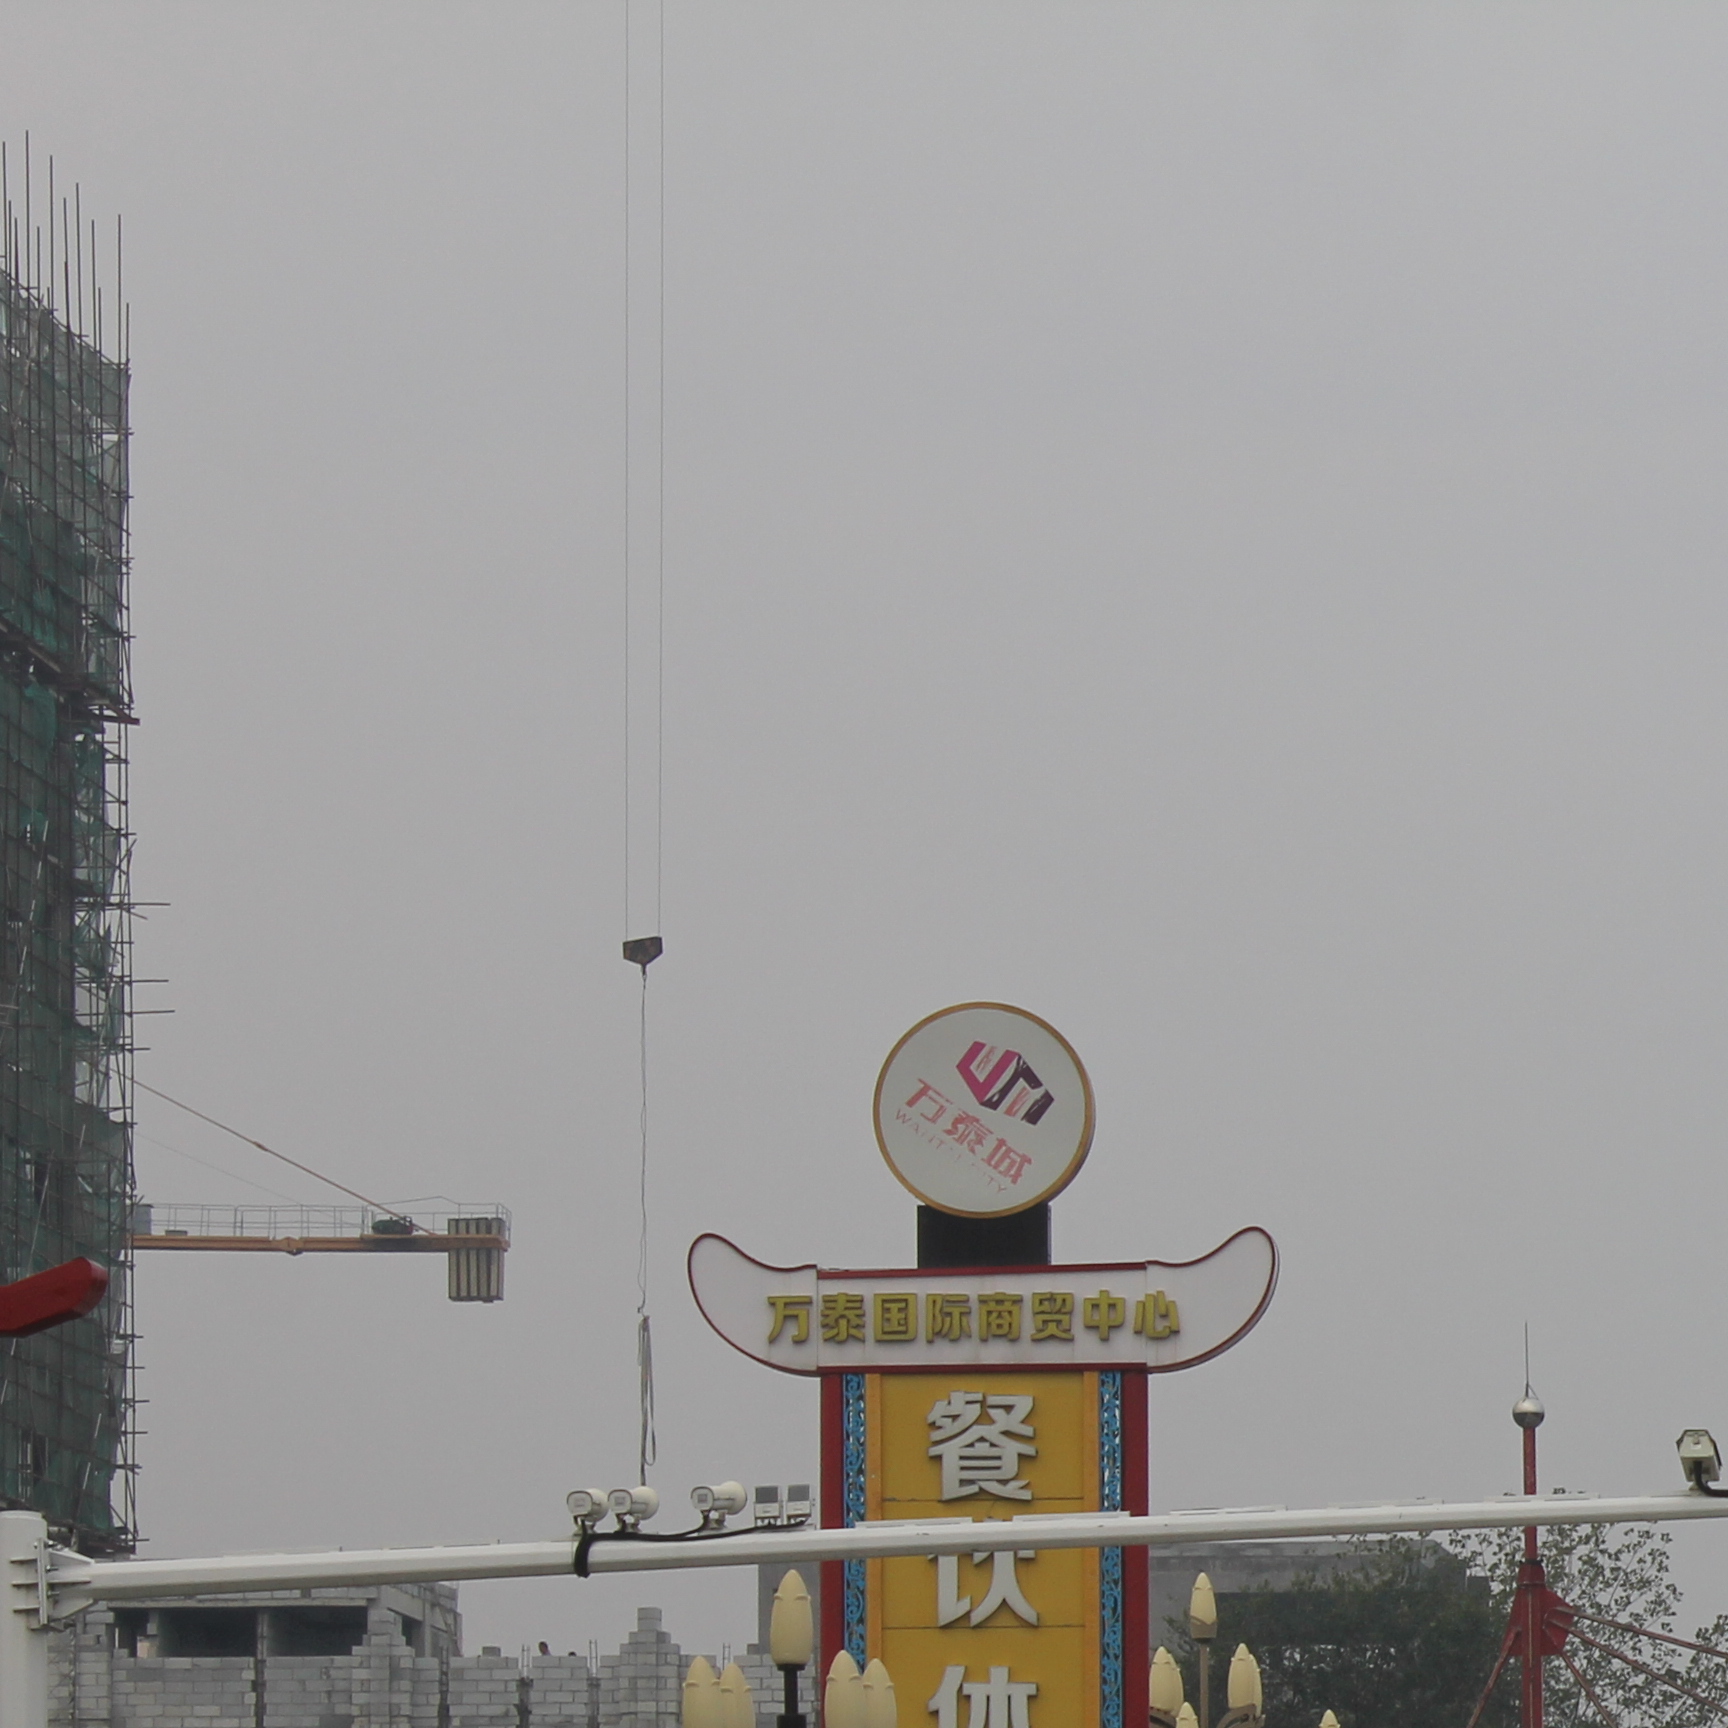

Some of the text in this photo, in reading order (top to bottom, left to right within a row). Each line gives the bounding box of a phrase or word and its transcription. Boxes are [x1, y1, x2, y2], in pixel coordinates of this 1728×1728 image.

[906, 1077, 1033, 1186] 万泰城
[766, 1288, 1181, 1345] 万泰国际商贸中心
